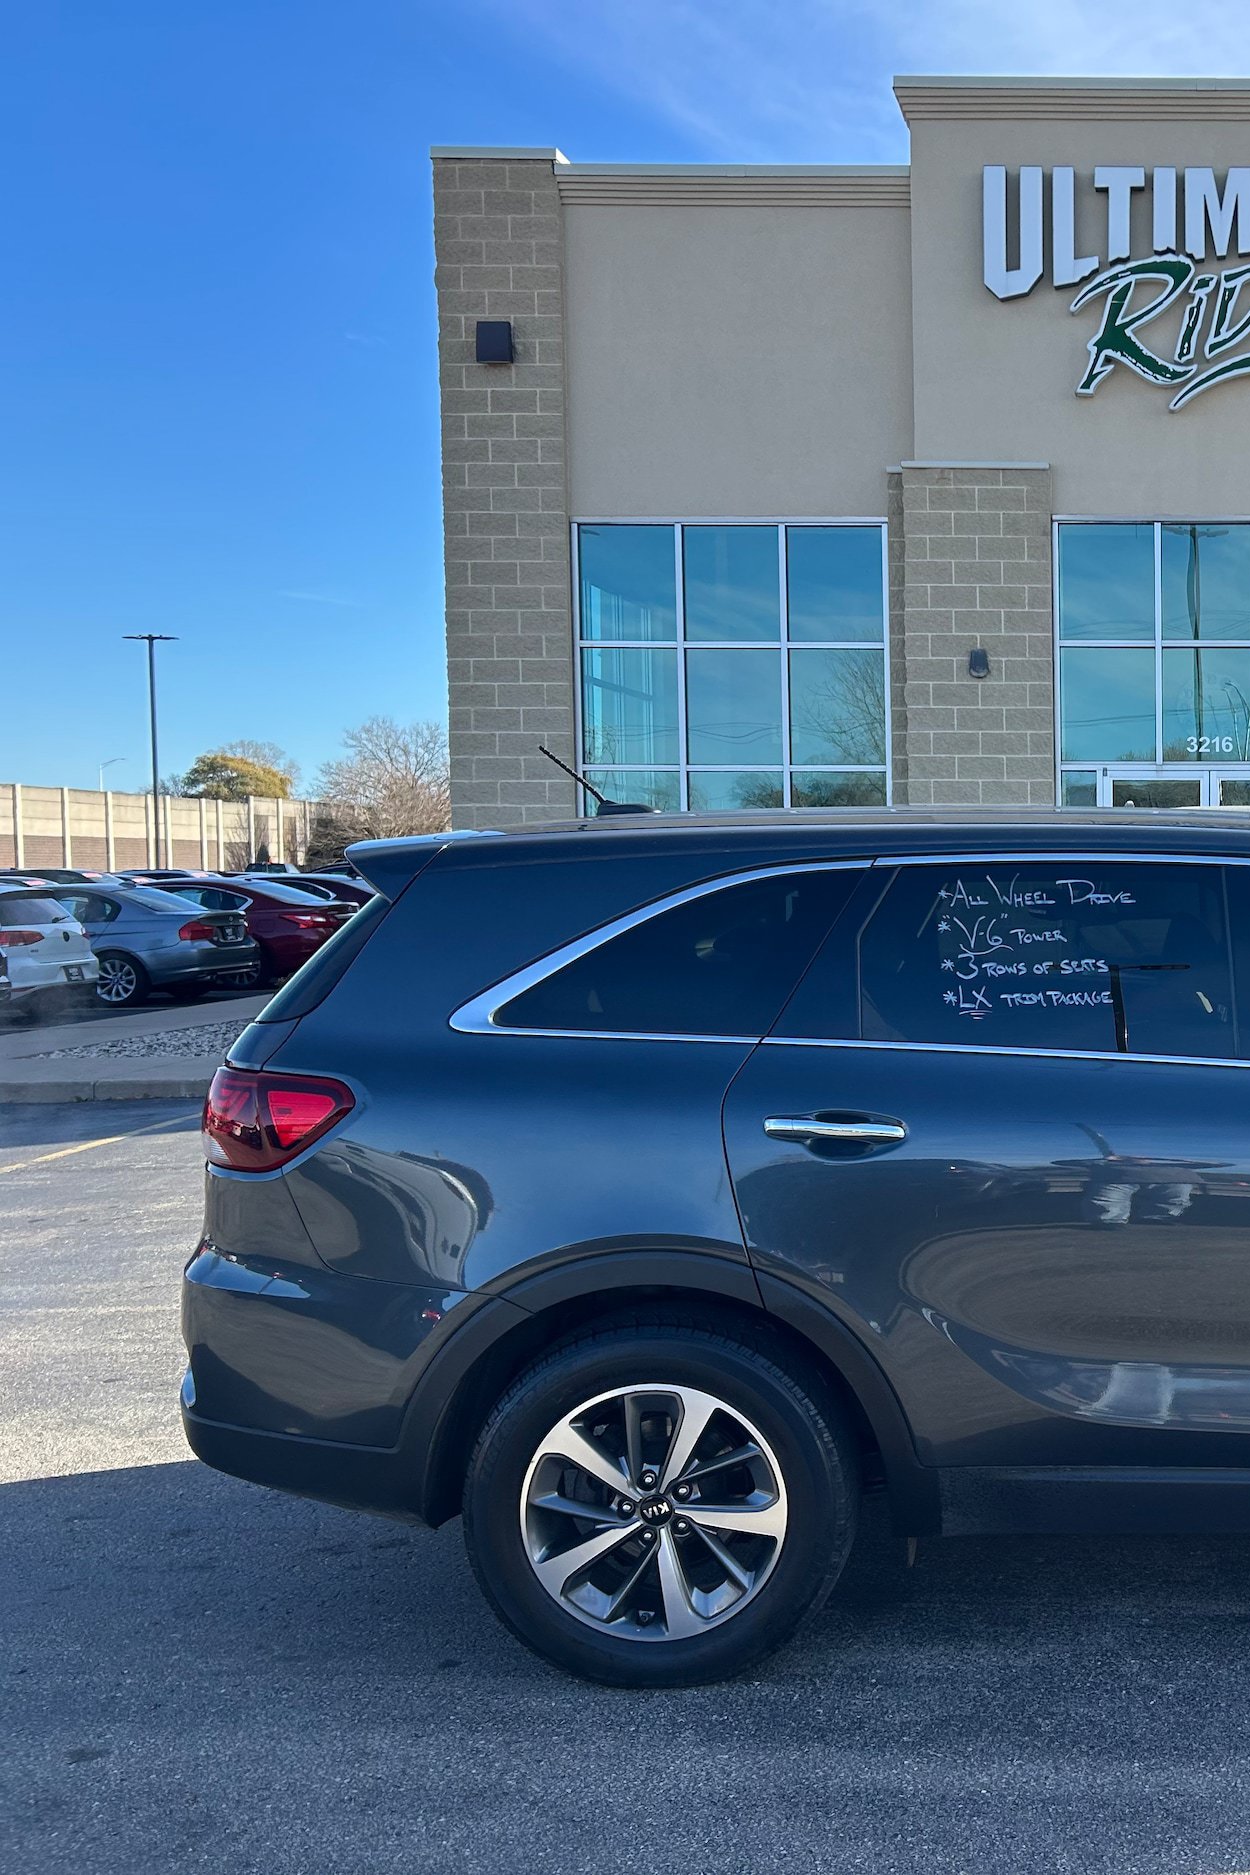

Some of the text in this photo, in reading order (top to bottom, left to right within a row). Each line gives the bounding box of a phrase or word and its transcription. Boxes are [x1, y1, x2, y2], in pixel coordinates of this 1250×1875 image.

[1186, 736, 1234, 753] 3216
[981, 961, 1028, 977] ROWS
[1032, 961, 1054, 974] OF
[1060, 958, 1110, 974] SEATS
[642, 1501, 670, 1519] KIA
